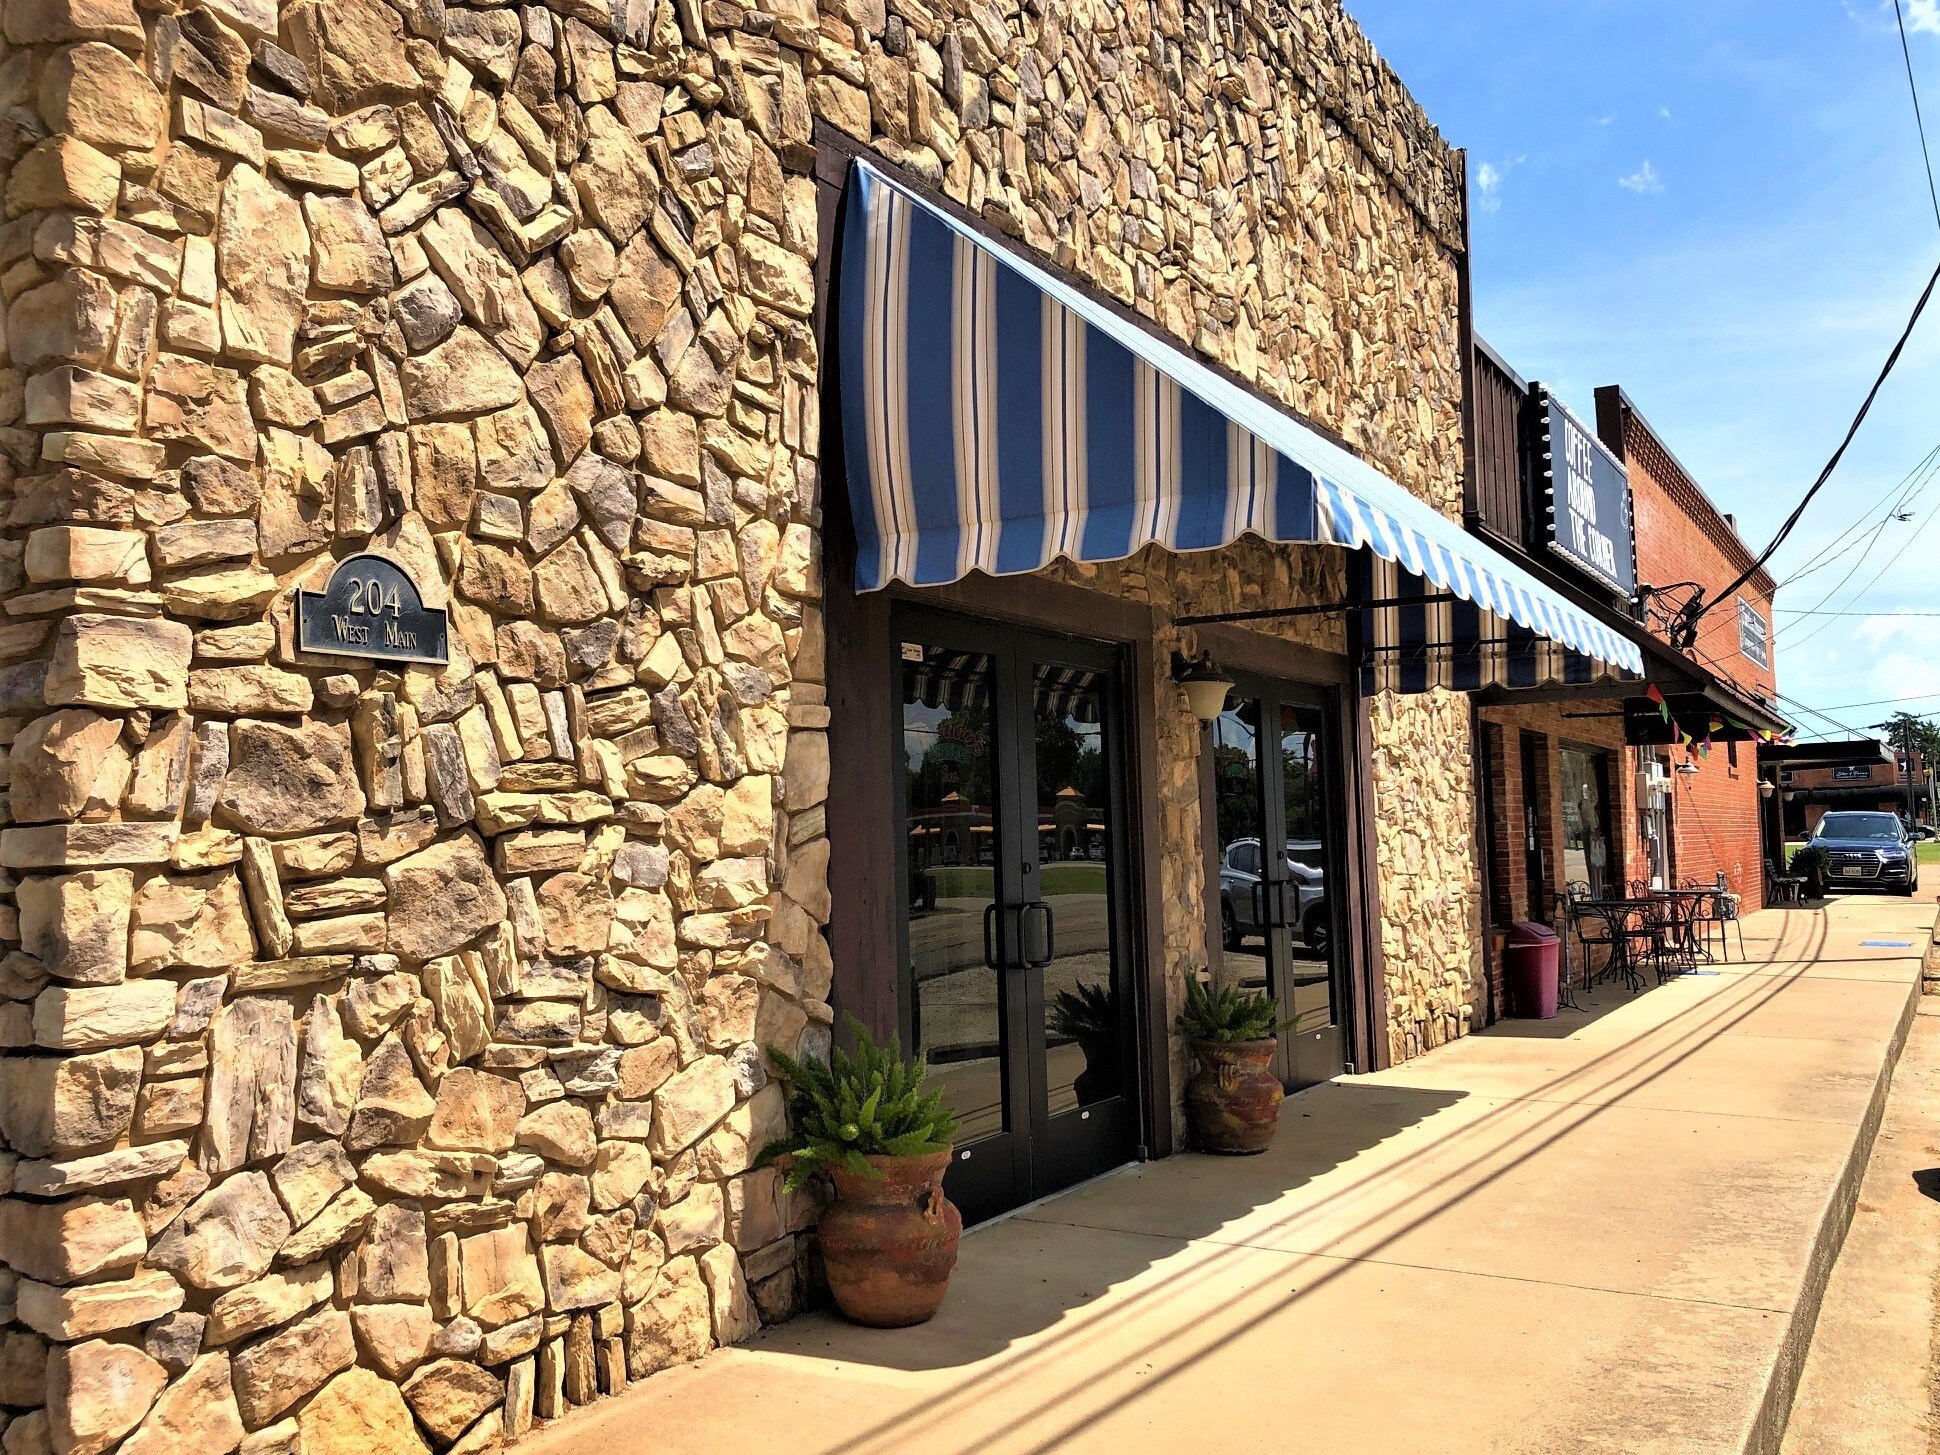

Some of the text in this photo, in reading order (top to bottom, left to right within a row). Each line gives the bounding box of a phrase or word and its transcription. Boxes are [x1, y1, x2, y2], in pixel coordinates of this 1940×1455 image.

[1564, 418, 1594, 484] COFFEE
[1567, 466, 1597, 526] AROUND
[1568, 506, 1618, 579] THE CORNER
[348, 577, 402, 618] 204
